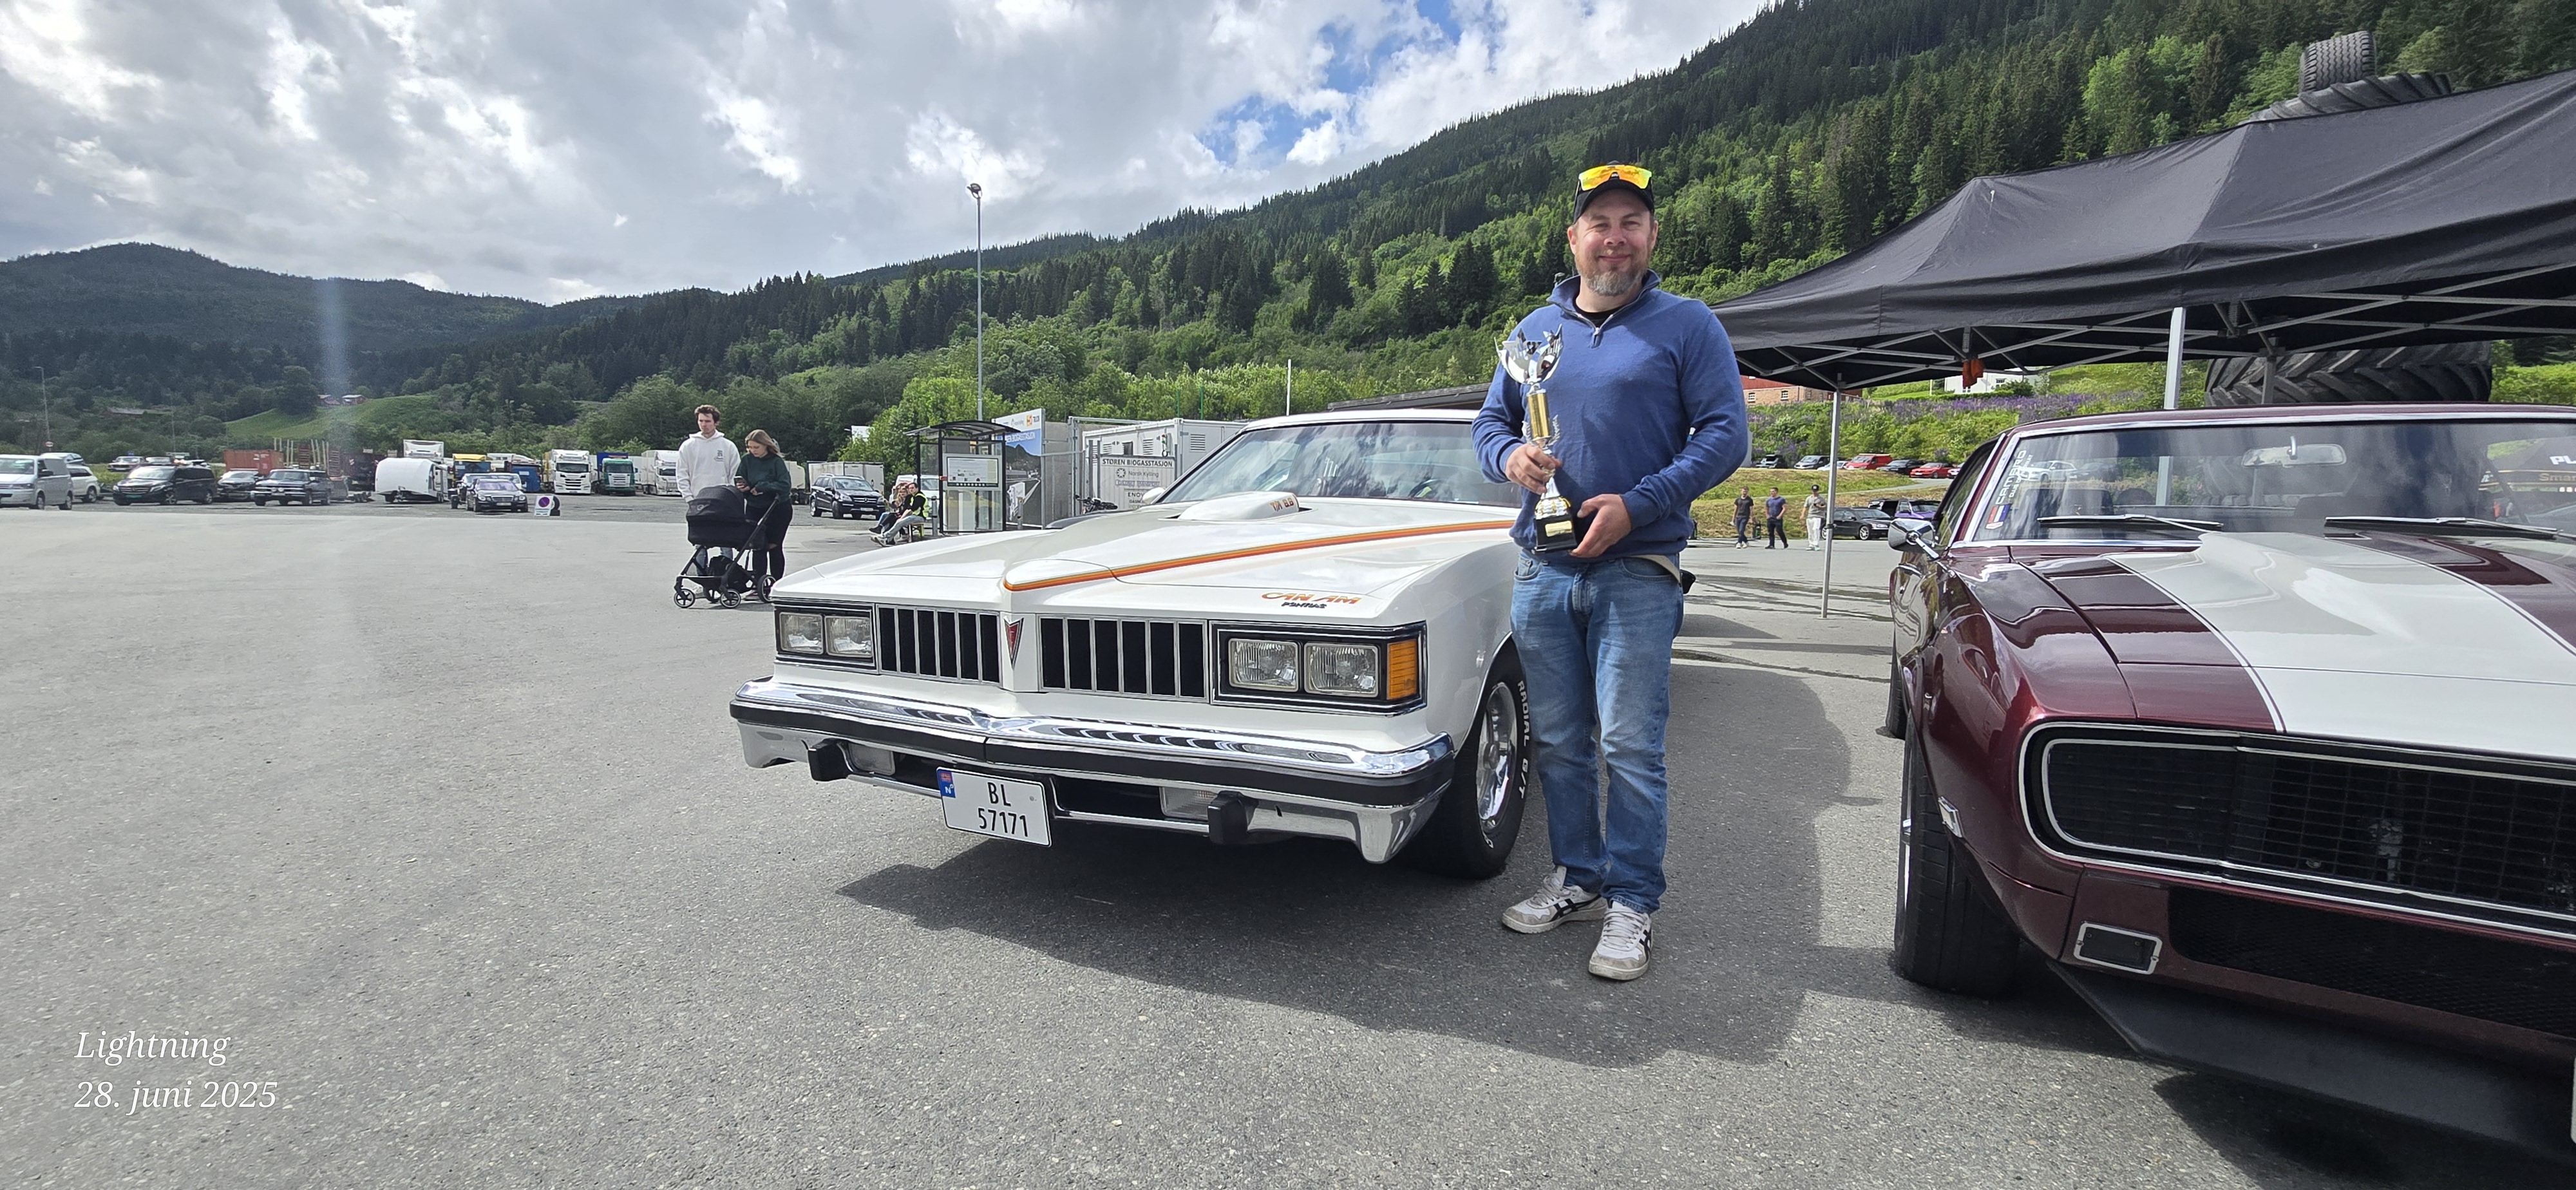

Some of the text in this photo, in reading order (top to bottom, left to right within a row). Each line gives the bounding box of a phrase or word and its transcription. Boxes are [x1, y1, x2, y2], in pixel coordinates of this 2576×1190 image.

[1995, 450, 2027, 505] CAMARO
[1261, 592, 1362, 605] CAN AM
[1517, 680, 1531, 799] RADIAL G/T
[987, 782, 1012, 807] BL
[978, 808, 1028, 837] 57171
